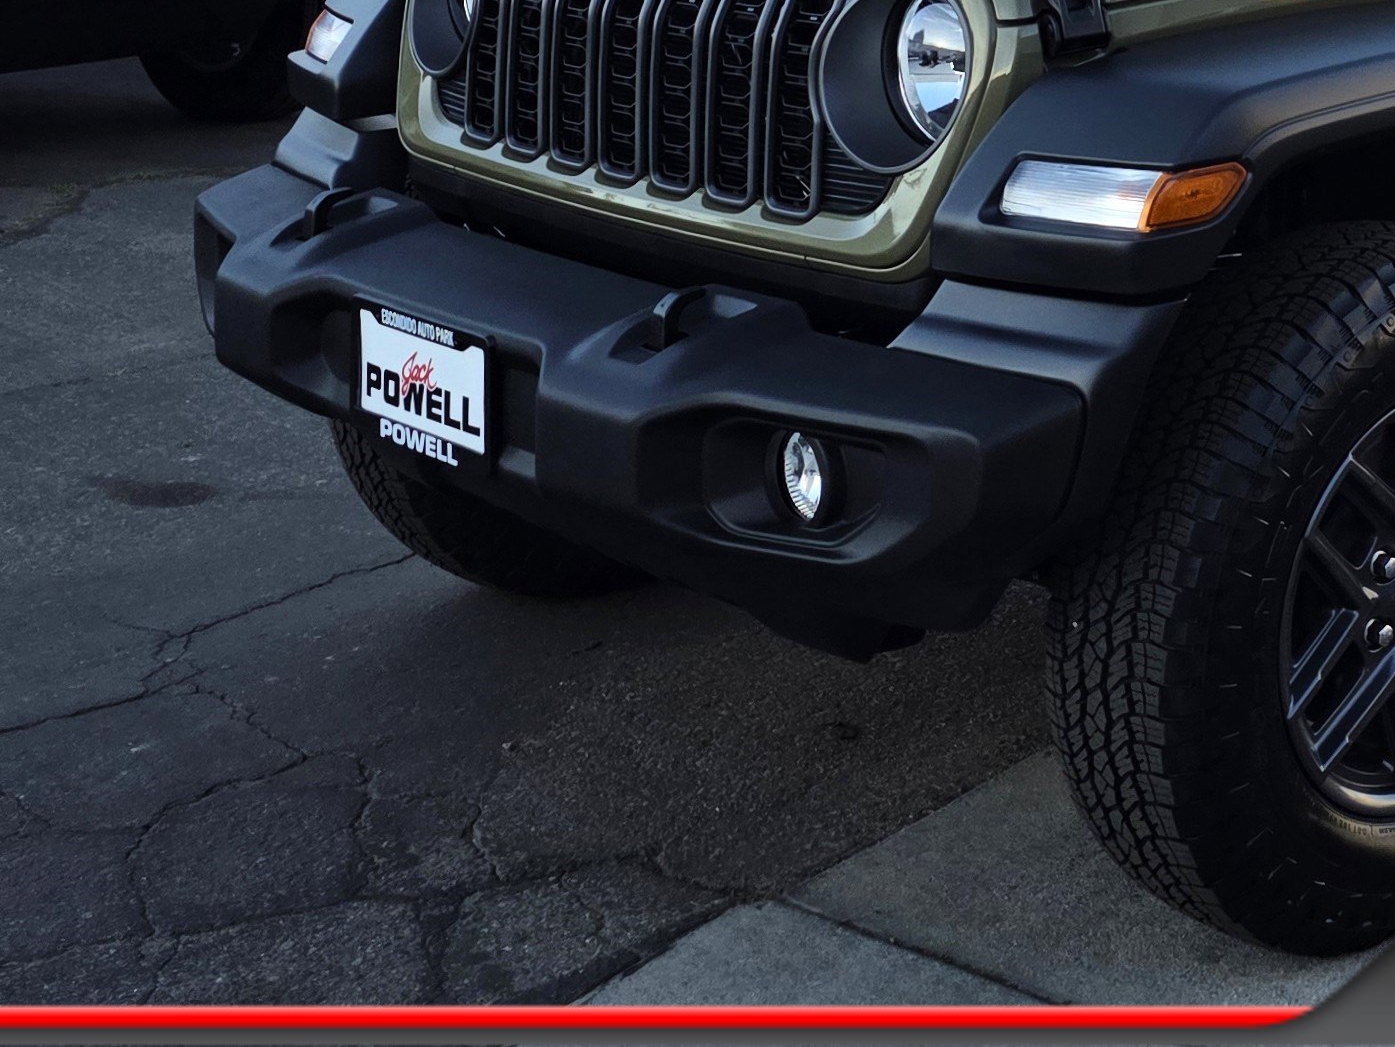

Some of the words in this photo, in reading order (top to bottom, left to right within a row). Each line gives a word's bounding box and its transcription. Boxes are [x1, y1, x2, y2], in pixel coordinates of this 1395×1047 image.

[381, 308, 417, 335] ESCONDIDO
[417, 320, 435, 341] AUTO
[435, 327, 455, 347] PARK
[401, 351, 438, 396] Jack
[366, 361, 481, 438] POWELL
[379, 417, 459, 467] POWELL
